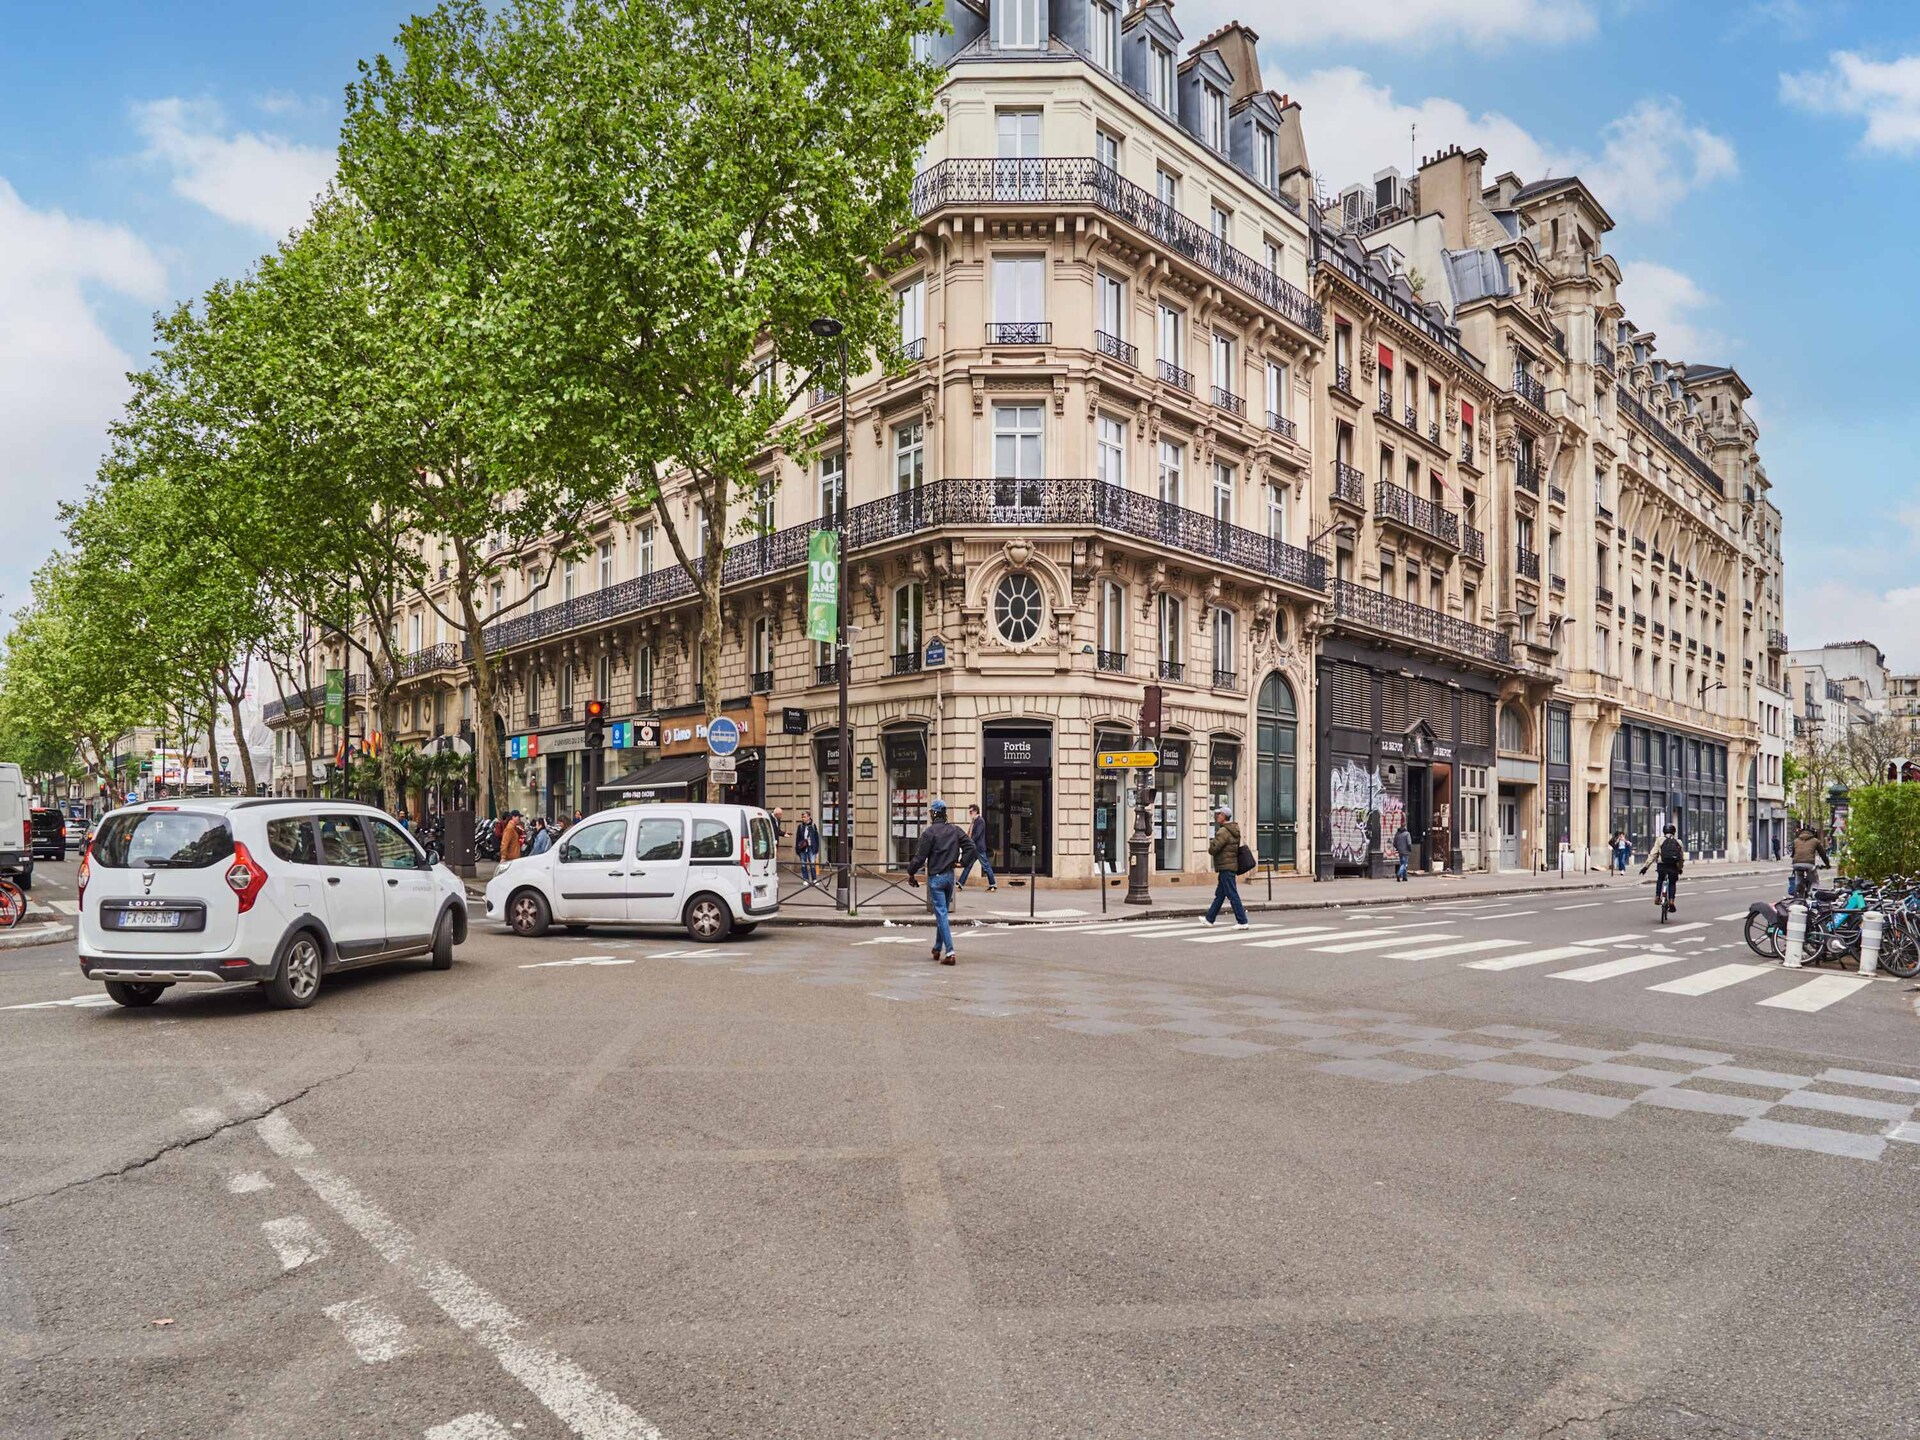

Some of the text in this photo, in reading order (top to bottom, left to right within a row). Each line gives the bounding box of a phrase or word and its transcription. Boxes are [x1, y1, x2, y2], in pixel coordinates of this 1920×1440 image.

[811, 561, 836, 582] 10
[811, 582, 835, 594] ANS
[1003, 741, 1031, 751] Fortis
[827, 749, 840, 758] Forti
[1003, 751, 1031, 759] immo
[1163, 749, 1179, 758] Fortis
